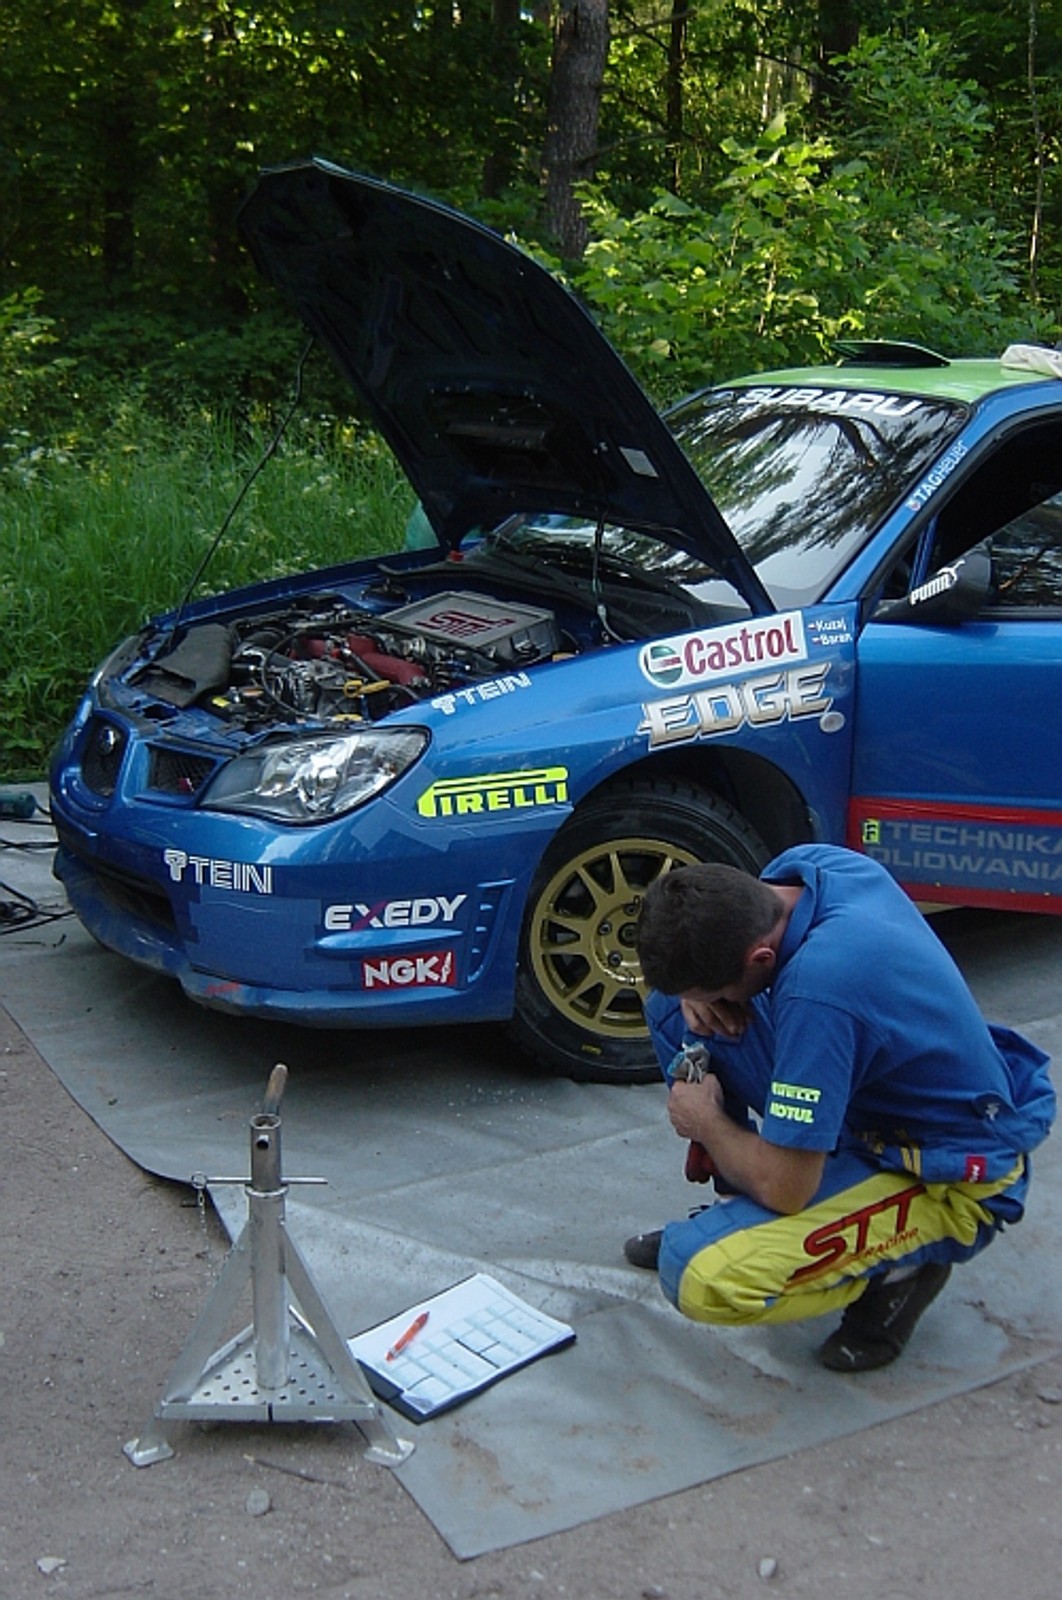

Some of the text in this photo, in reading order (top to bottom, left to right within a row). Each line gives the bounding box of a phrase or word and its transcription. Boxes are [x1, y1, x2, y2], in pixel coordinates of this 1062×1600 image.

[737, 386, 922, 416] SUBARU
[684, 619, 799, 675] Castrol
[456, 672, 532, 705] TEIN
[636, 662, 833, 752] EDGE
[417, 766, 568, 817] PIRELLI
[189, 856, 272, 893] TEIN
[324, 894, 468, 932] EXEDY
[364, 955, 440, 988] NGK
